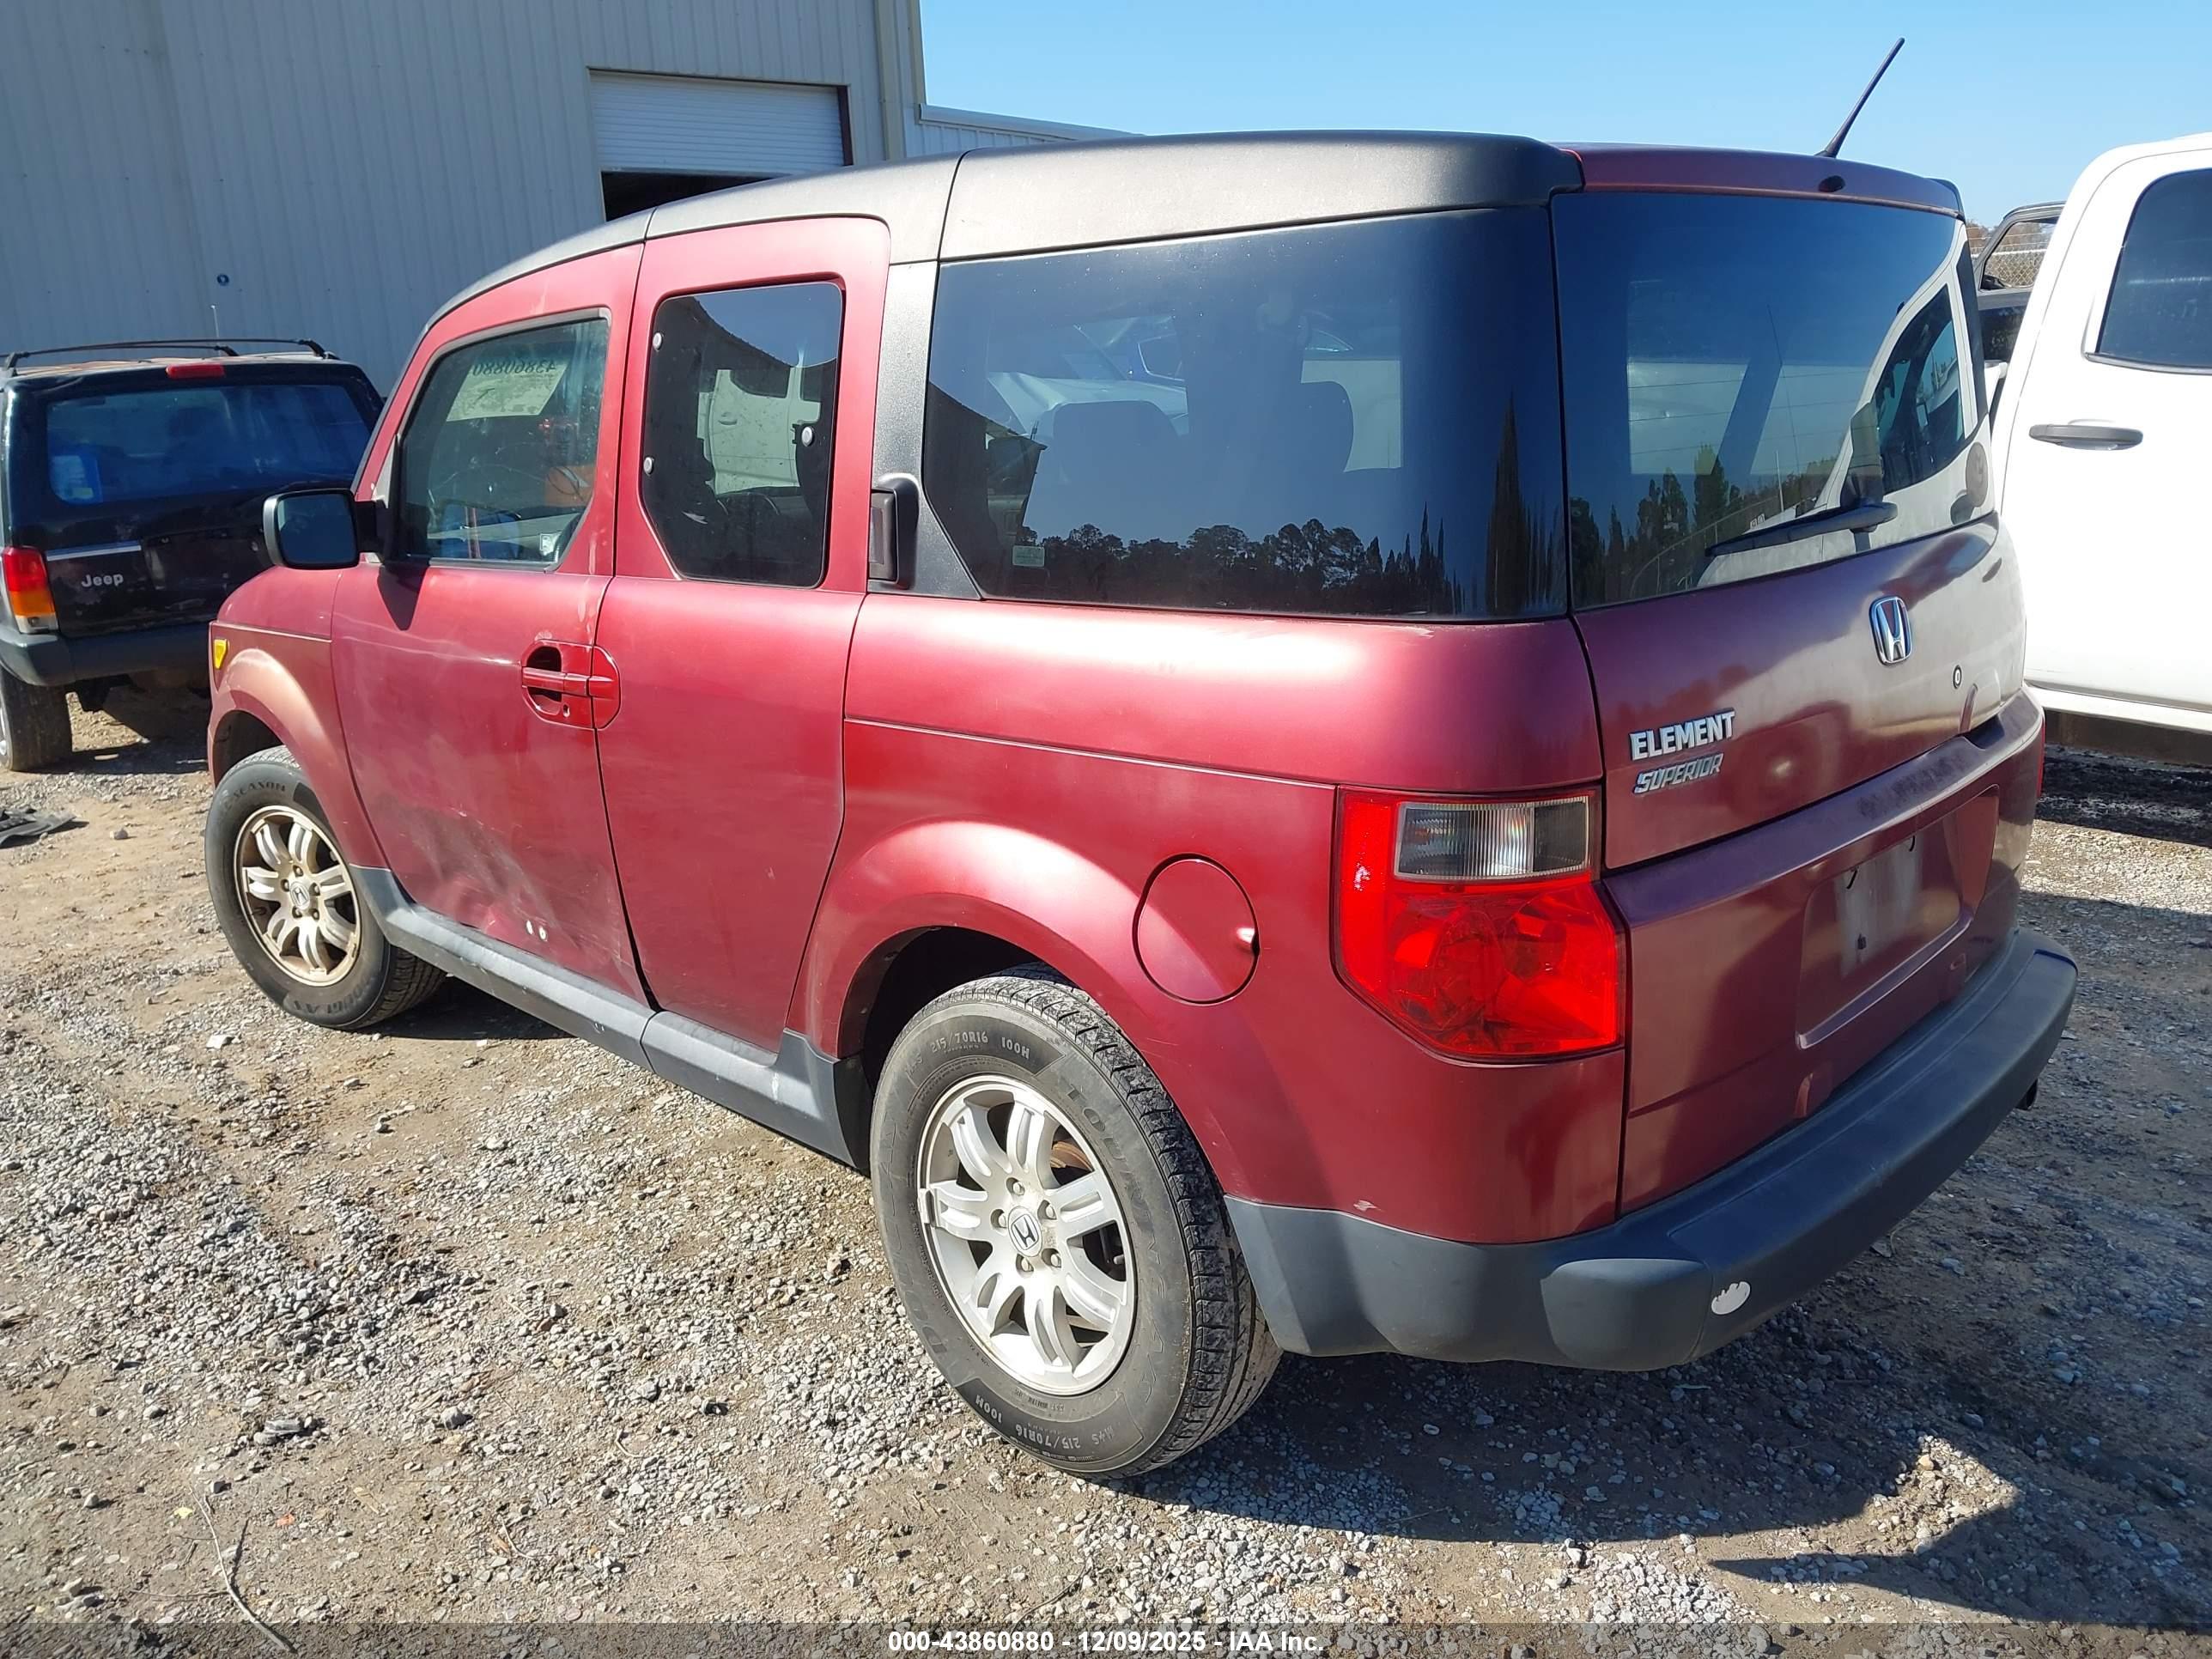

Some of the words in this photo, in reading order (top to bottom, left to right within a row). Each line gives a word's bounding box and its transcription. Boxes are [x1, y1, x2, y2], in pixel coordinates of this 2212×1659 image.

[82, 574, 124, 587] Jeep
[1630, 709, 1735, 761] ELEMENT
[1633, 752, 1724, 794] SUPERIOR
[931, 1031, 988, 1054] 215/70R16
[1001, 1036, 1030, 1060] 100H
[975, 1395, 1002, 1423] 100H
[1015, 1424, 1081, 1449] 215/70R16
